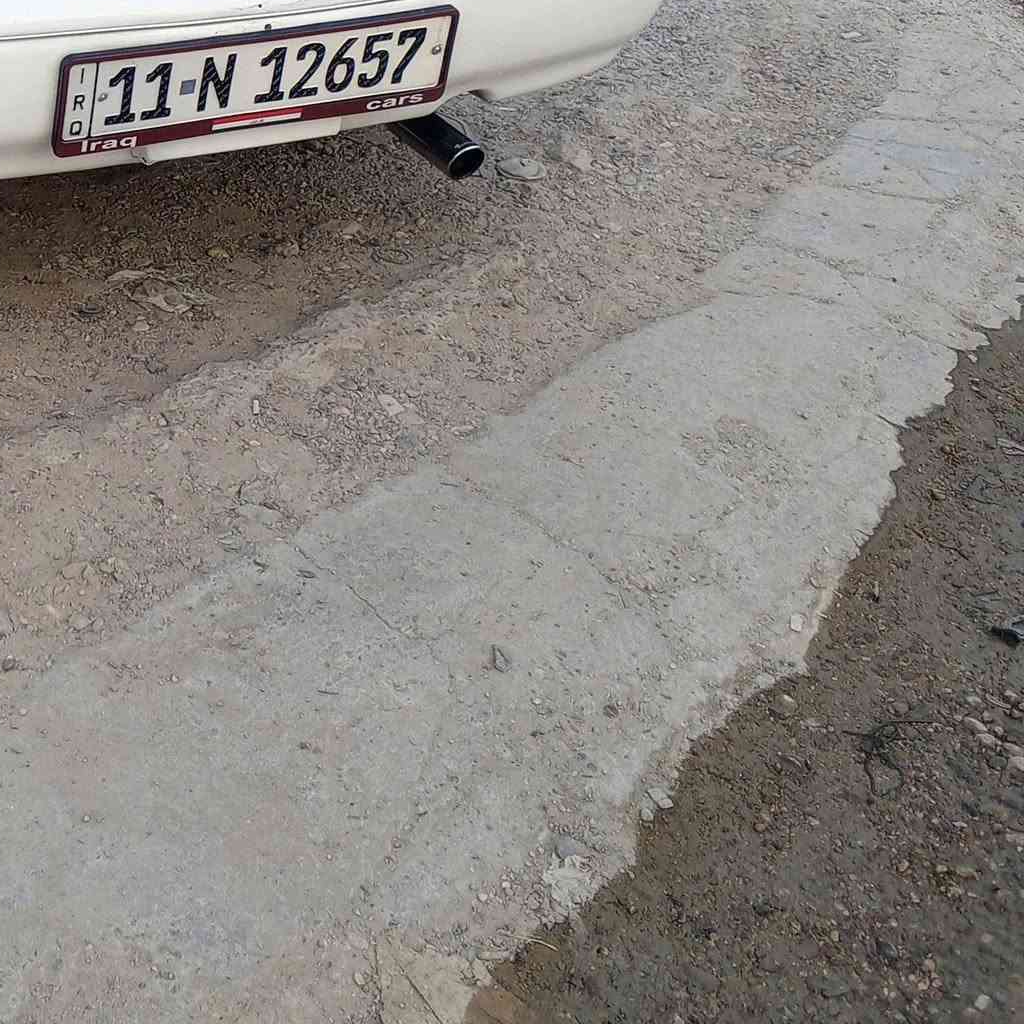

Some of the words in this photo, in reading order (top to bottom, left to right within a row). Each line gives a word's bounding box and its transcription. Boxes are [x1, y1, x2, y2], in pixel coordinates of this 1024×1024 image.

[254, 27, 428, 105] 12657
[80, 136, 138, 153] Iraq
[366, 93, 424, 111] cars
